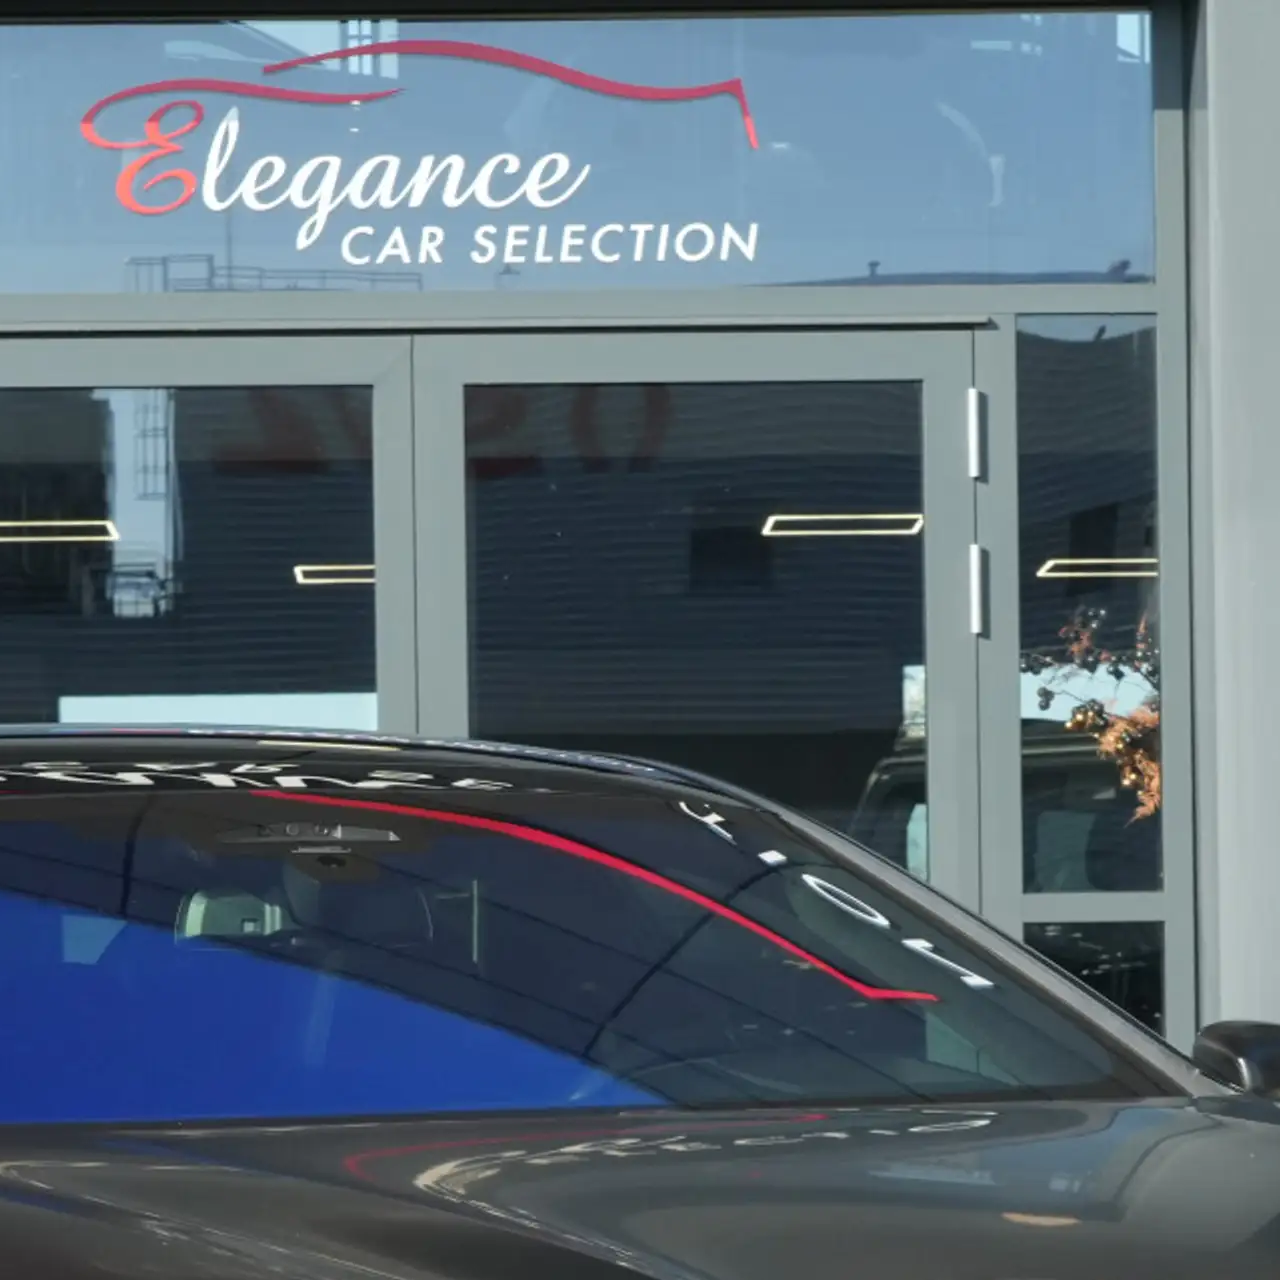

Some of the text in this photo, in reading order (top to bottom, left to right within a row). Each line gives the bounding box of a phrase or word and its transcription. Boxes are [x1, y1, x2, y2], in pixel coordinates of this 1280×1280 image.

[80, 78, 591, 250] Elegance
[340, 222, 759, 265] CAR SELECTION
